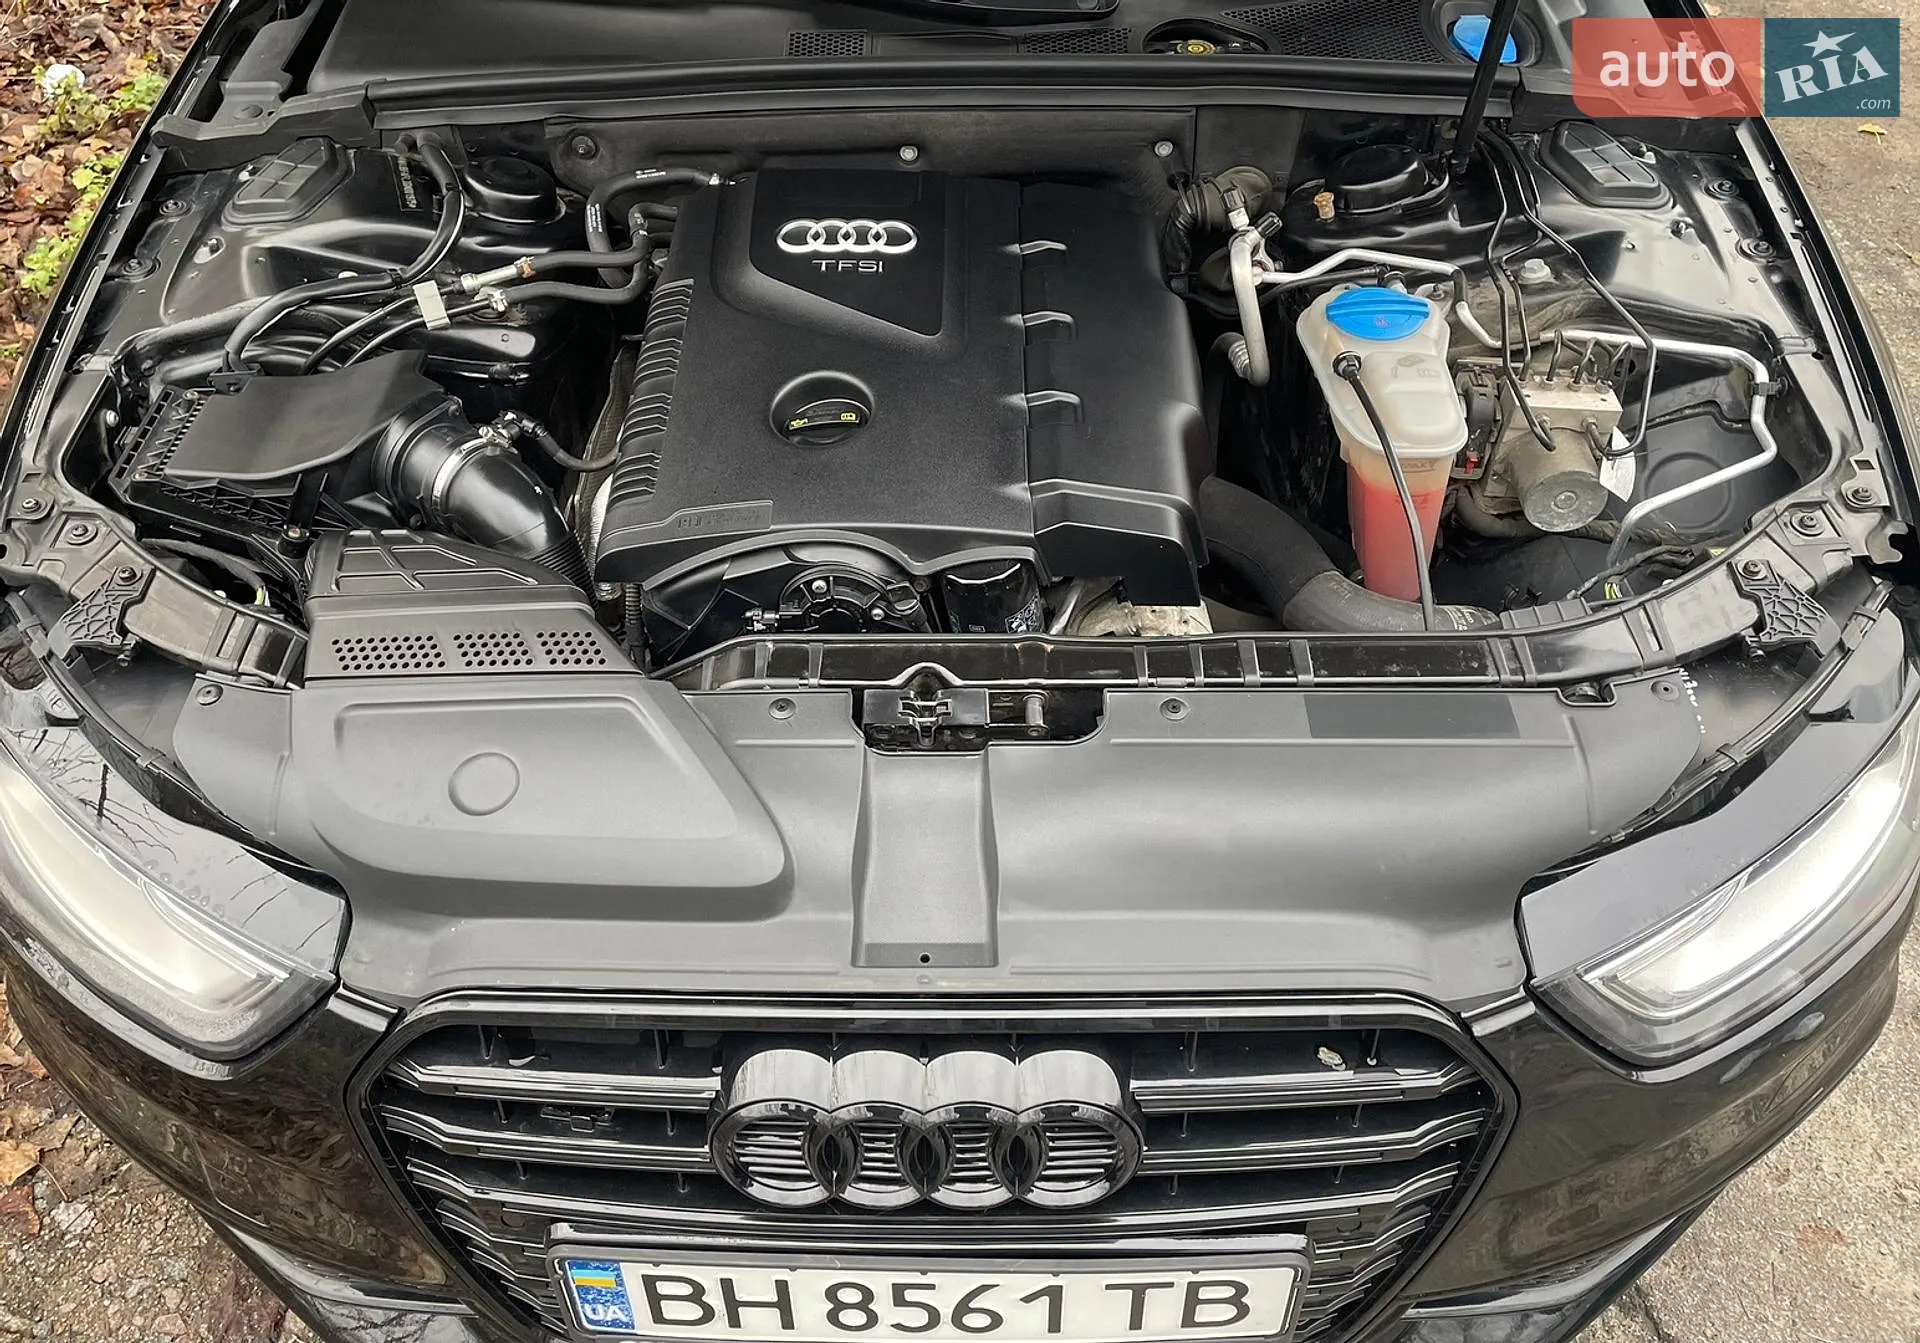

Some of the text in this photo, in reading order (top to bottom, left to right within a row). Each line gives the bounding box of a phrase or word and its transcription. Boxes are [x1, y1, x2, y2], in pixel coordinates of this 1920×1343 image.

[812, 260, 883, 272] TFSI
[584, 1303, 627, 1321] UA
[641, 1274, 1251, 1333] BH 8561 TB
